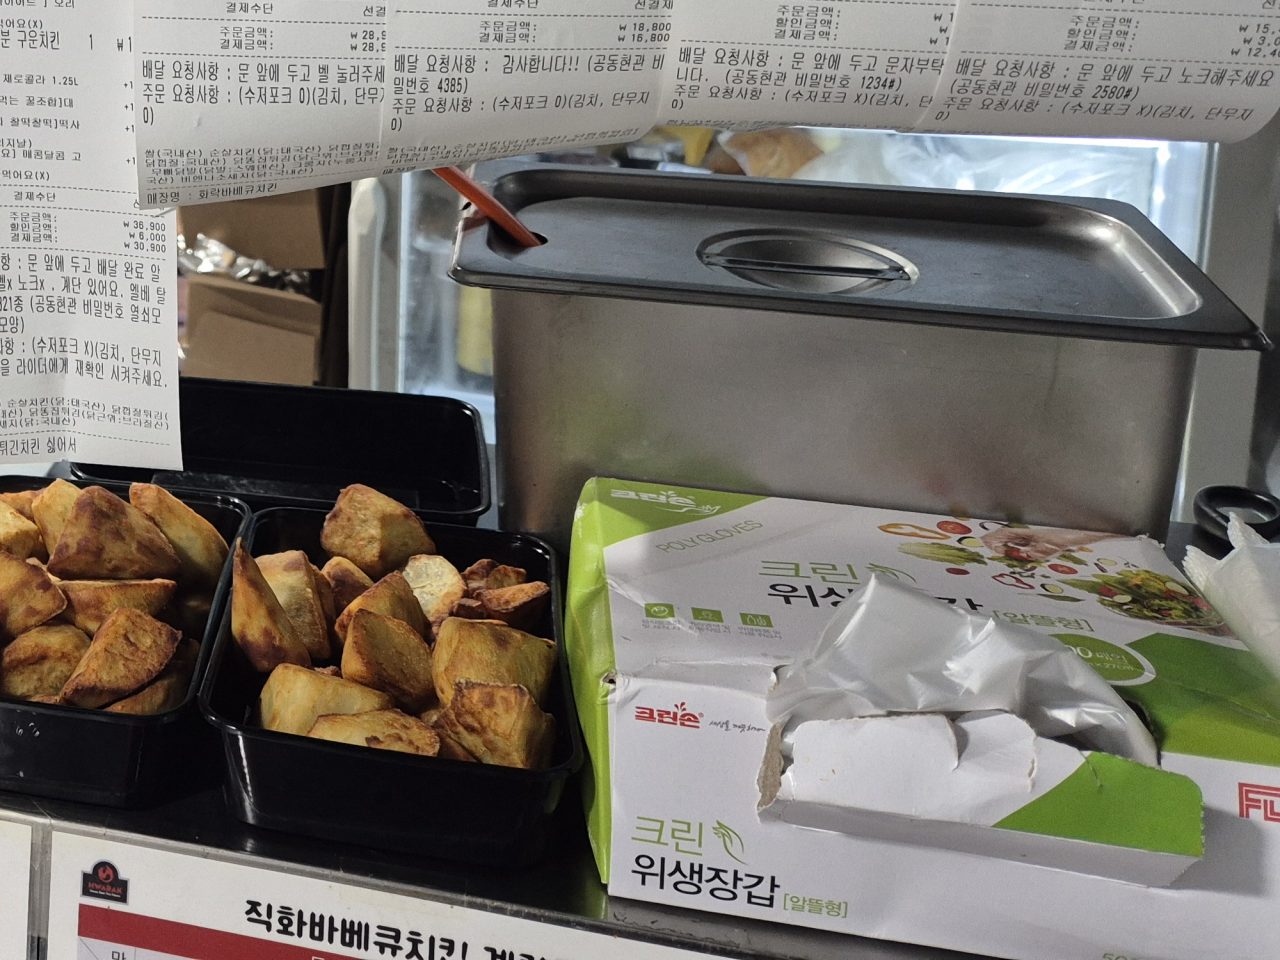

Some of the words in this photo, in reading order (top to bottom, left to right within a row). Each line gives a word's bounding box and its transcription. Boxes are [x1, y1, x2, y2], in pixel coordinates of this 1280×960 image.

[634, 0, 674, 10] 선결제
[502, 55, 579, 74] 감사합니다!!
[32, 337, 78, 355] (수저포크
[131, 348, 161, 367] 단무지
[16, 358, 69, 375] 라이더에게
[75, 360, 104, 379] 재확인
[111, 365, 167, 388] 시켜주세요.
[0, 439, 40, 456] 튀긴치킨
[47, 437, 77, 453] 싫어서
[656, 537, 700, 553] POLY
[700, 520, 763, 543] GLOVES
[758, 559, 860, 585] 크린
[634, 702, 701, 729] 크린손
[631, 816, 703, 856] 크린
[631, 854, 781, 908] 위생장갑
[783, 893, 848, 918] [알뜰형]
